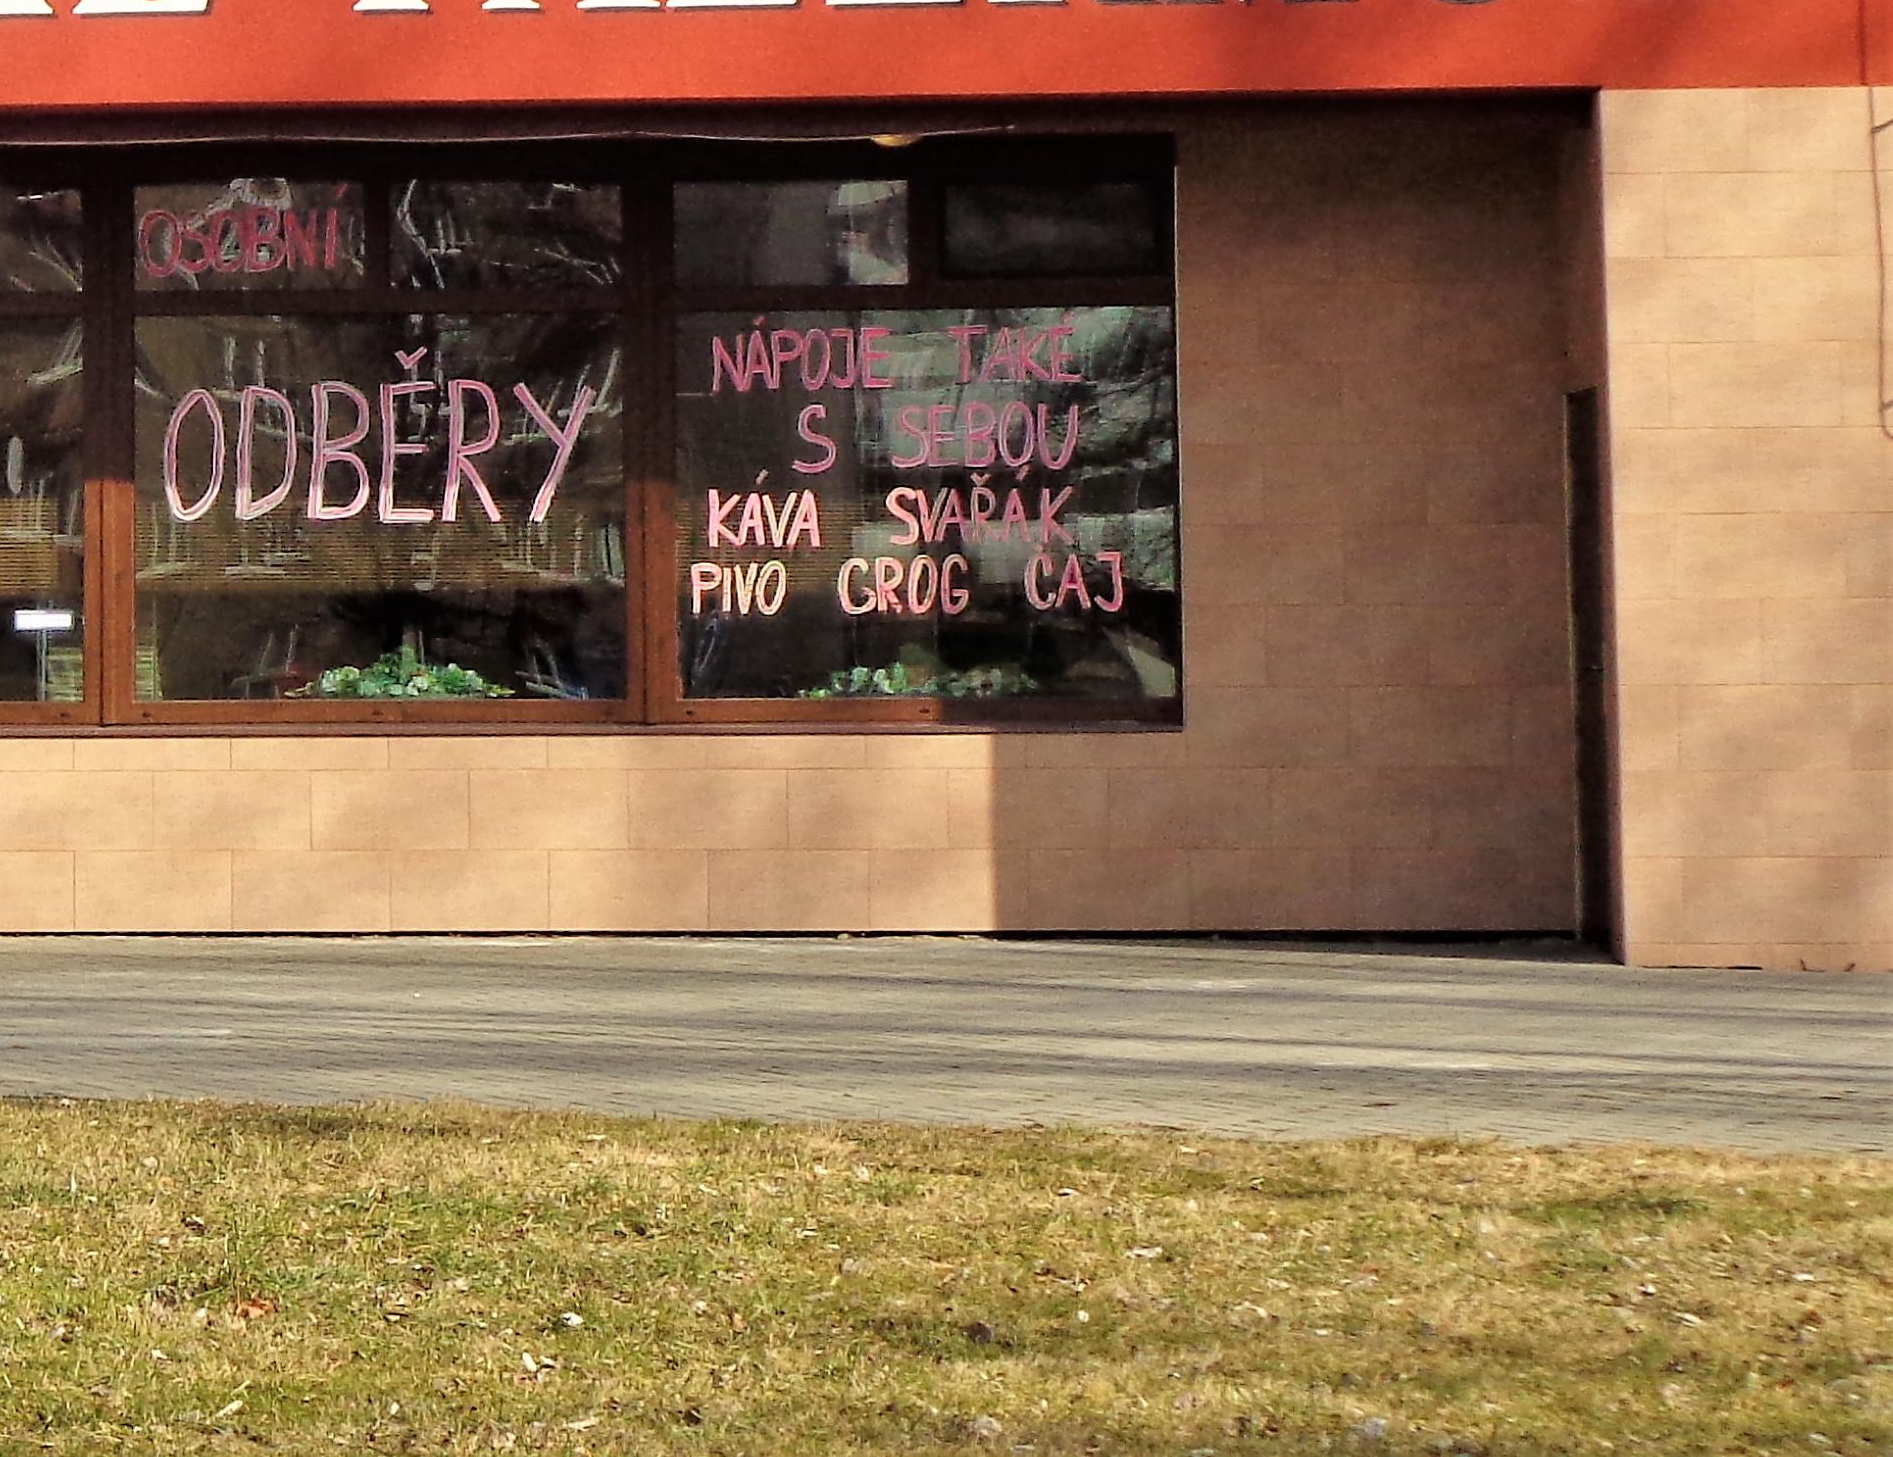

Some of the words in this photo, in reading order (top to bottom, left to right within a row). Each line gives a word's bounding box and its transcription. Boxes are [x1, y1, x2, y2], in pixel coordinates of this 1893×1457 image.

[138, 183, 346, 278] OSOBNÍ
[709, 317, 894, 395] NÁPOJE
[946, 310, 1083, 383] TAKÉ
[163, 346, 596, 523] ODBĚRY
[791, 404, 837, 474] S
[891, 401, 1079, 470] SEBOU
[708, 469, 821, 548] KÁVA
[885, 465, 1075, 545] SVAŘÁK
[690, 560, 787, 618] PIVO
[837, 553, 969, 615] GROG
